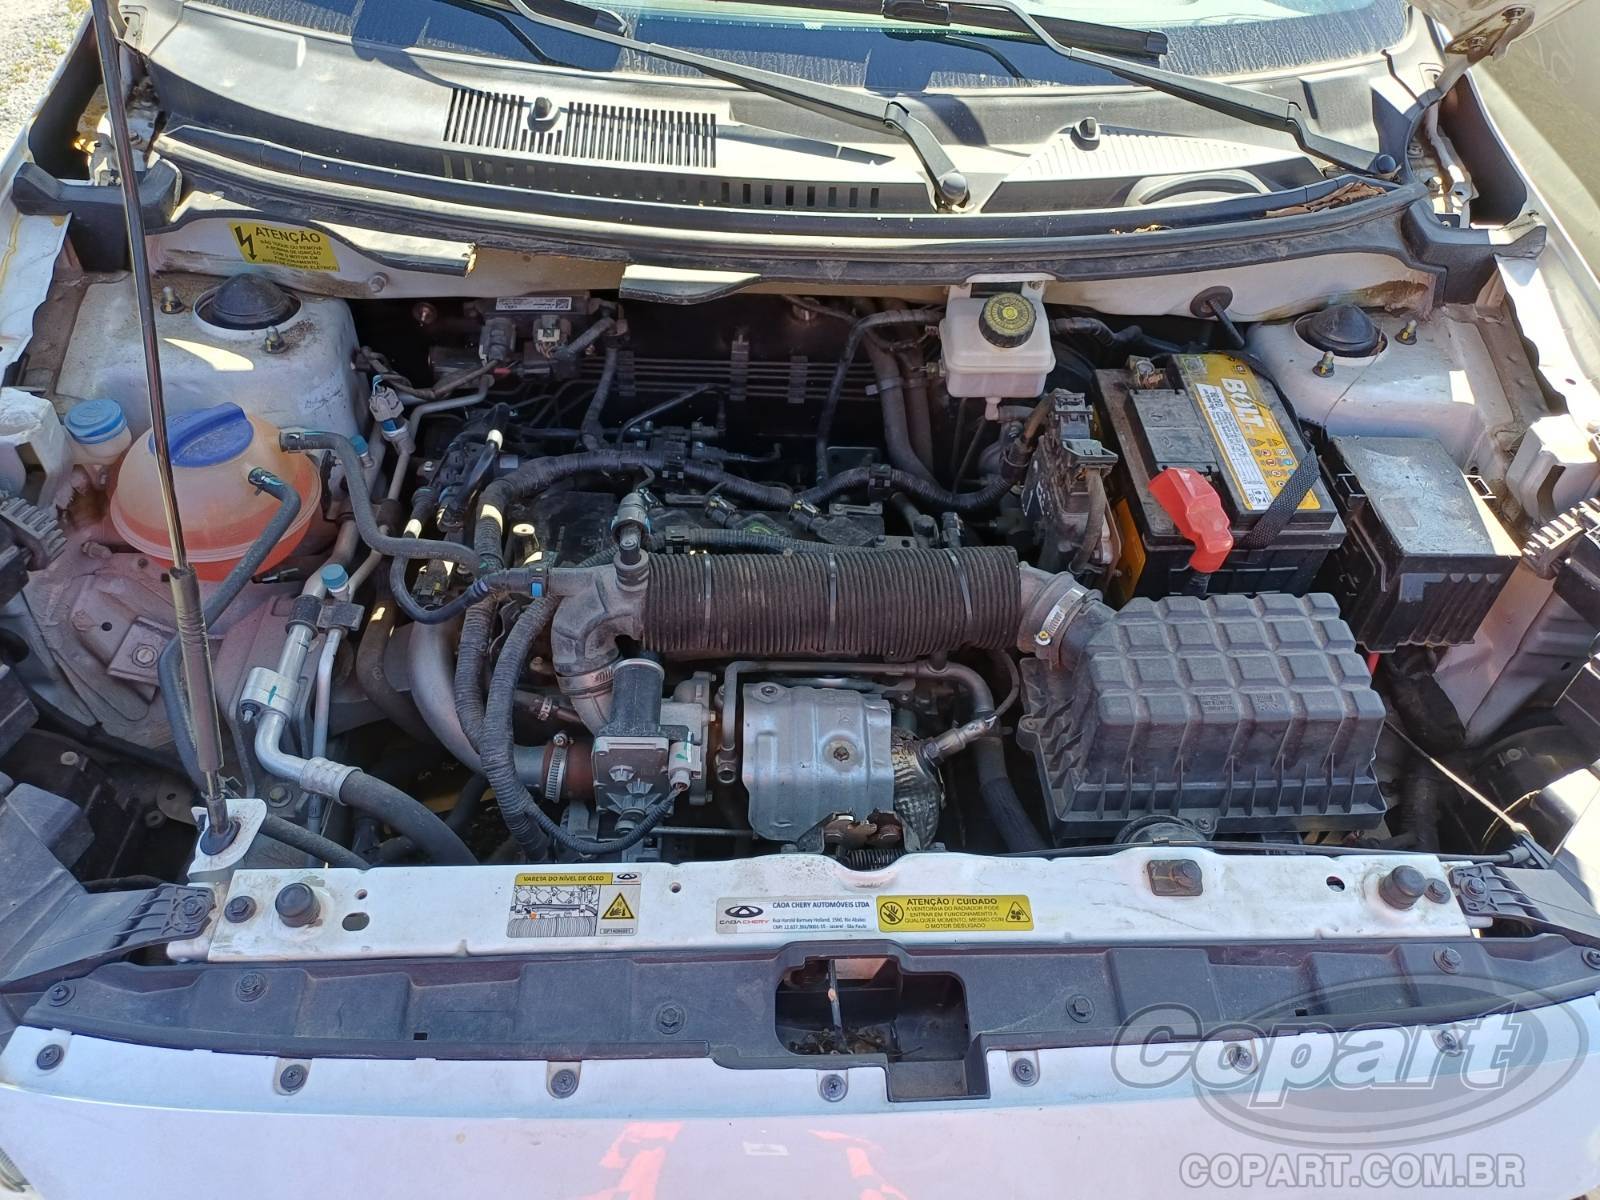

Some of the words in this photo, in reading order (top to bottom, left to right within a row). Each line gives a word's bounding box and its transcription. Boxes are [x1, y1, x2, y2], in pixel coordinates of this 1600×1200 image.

[255, 226, 321, 244] ATENÇÃO
[812, 900, 854, 908] AUTOMÓVEIS
[906, 897, 950, 906] ATENÇÃO
